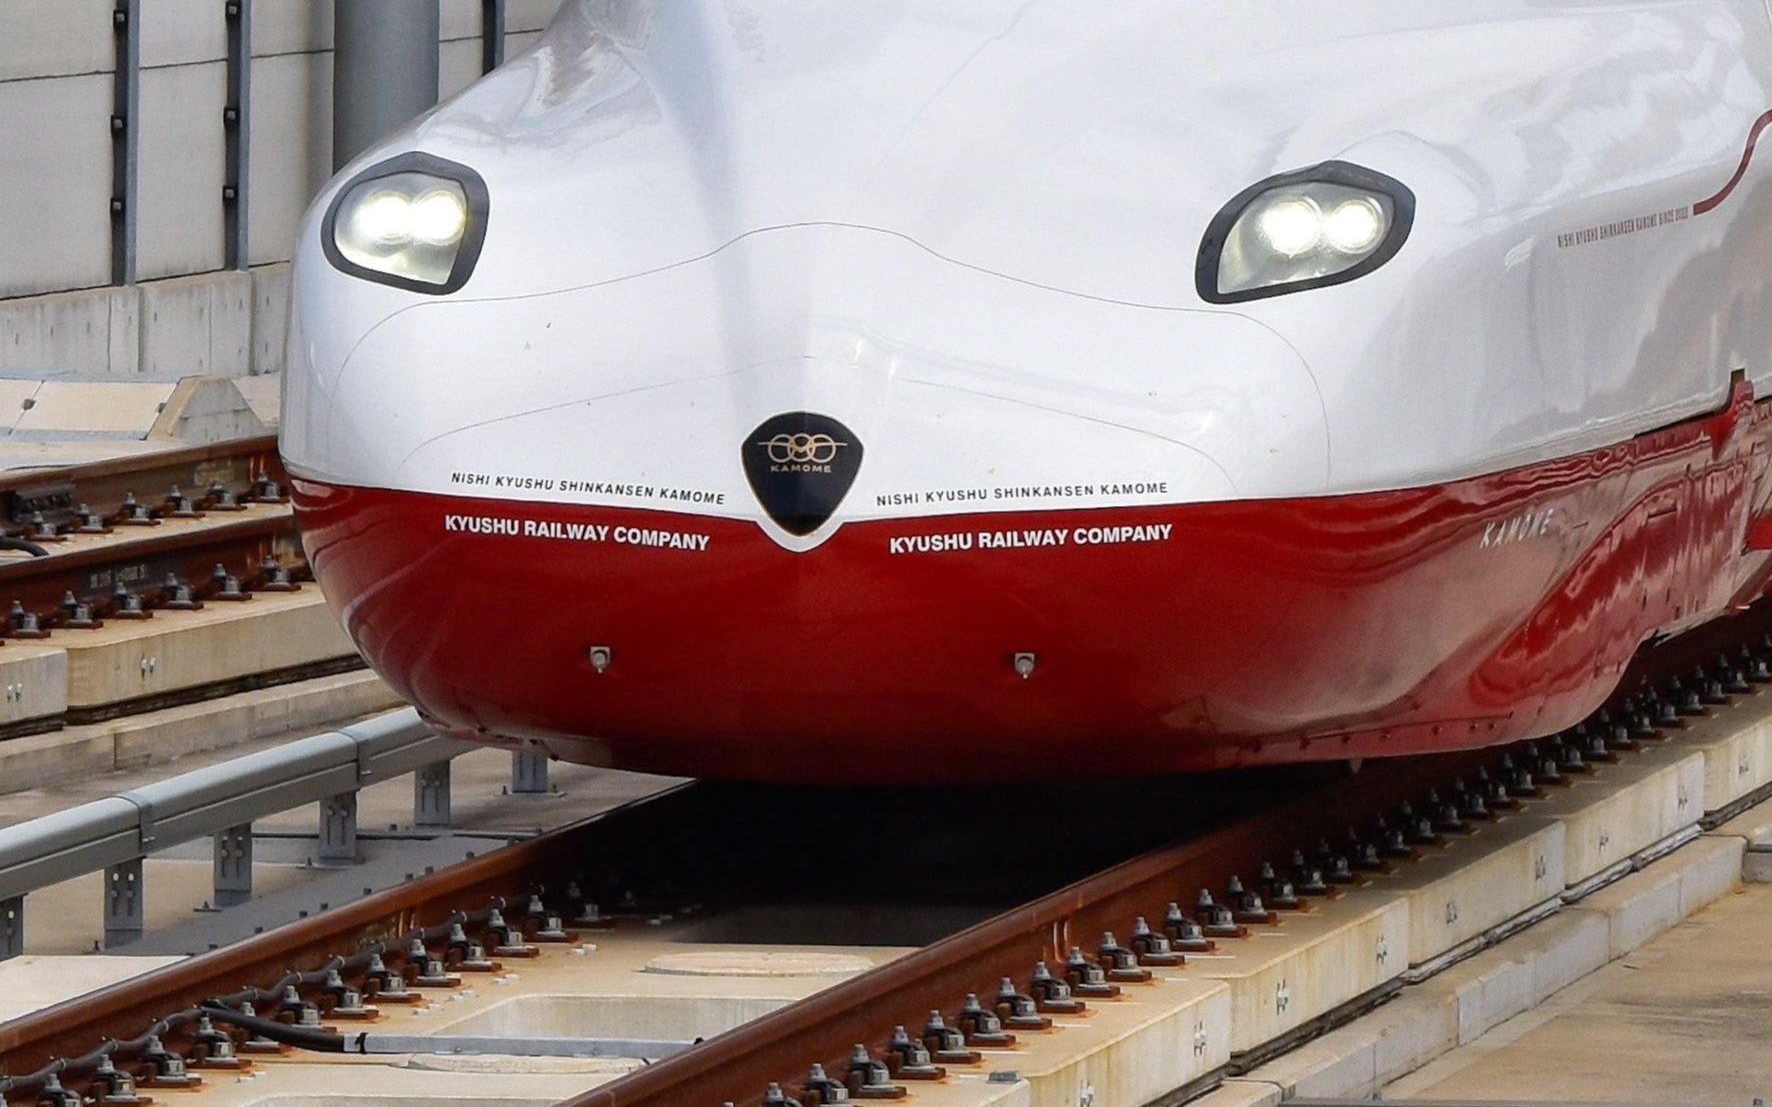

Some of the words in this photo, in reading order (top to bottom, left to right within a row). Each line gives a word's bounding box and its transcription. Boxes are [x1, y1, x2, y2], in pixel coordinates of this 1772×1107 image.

[770, 464, 832, 473] KAMOME
[451, 472, 490, 486] NISHI
[495, 476, 554, 490] KYUSHU
[559, 480, 654, 497] SHINKANSEN
[659, 488, 725, 505] KAMOME
[877, 493, 919, 507] NISHI
[925, 489, 988, 503] KYUSHU
[994, 485, 1094, 499] SHINKANSEN
[1100, 482, 1168, 495] KAMOME
[445, 514, 519, 536] KYUSHU
[523, 520, 610, 541] RAILWAY
[613, 526, 710, 551] COMPANY
[889, 533, 972, 554] KYUSHU
[978, 528, 1069, 549] RAILWAY
[1073, 523, 1173, 544] COMPANY
[1480, 508, 1554, 549] KAMOME
